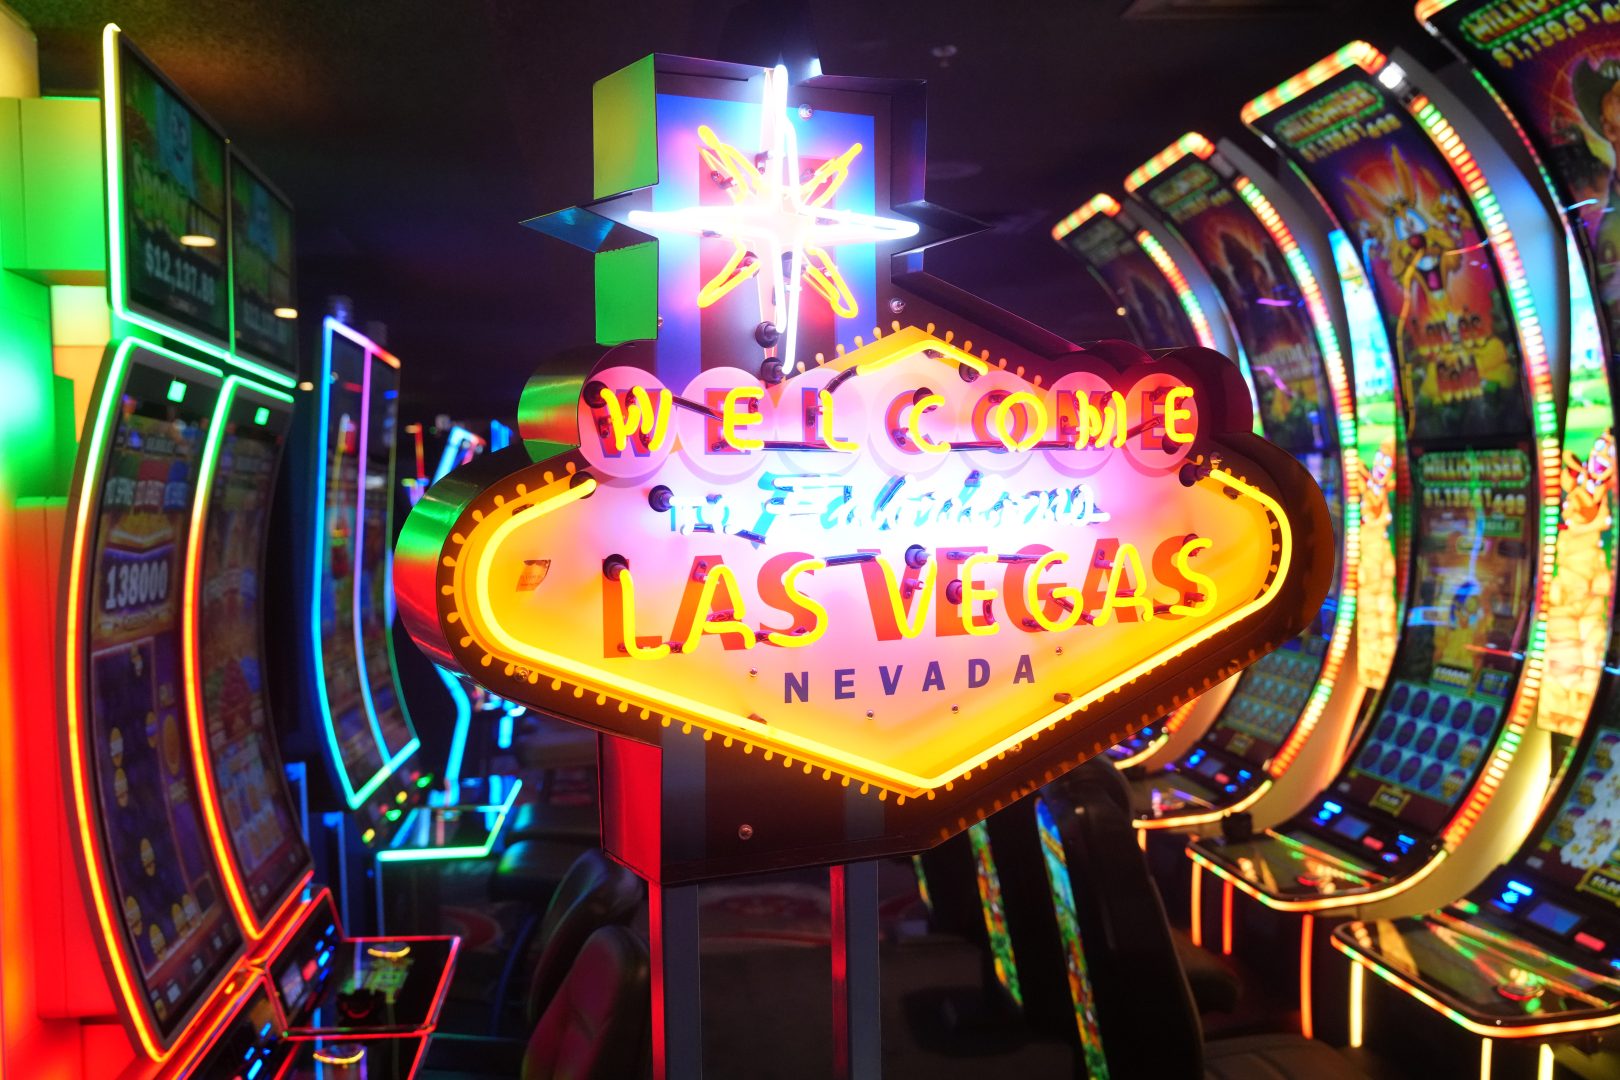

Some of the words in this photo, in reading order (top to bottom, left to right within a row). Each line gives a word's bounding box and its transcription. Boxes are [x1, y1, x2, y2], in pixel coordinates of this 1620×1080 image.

[592, 385, 1195, 459] WELCOME
[105, 560, 168, 609] 138000
[602, 546, 829, 661] LAS
[867, 534, 1220, 642] VEGAS
[783, 653, 1036, 705] NEVADA
